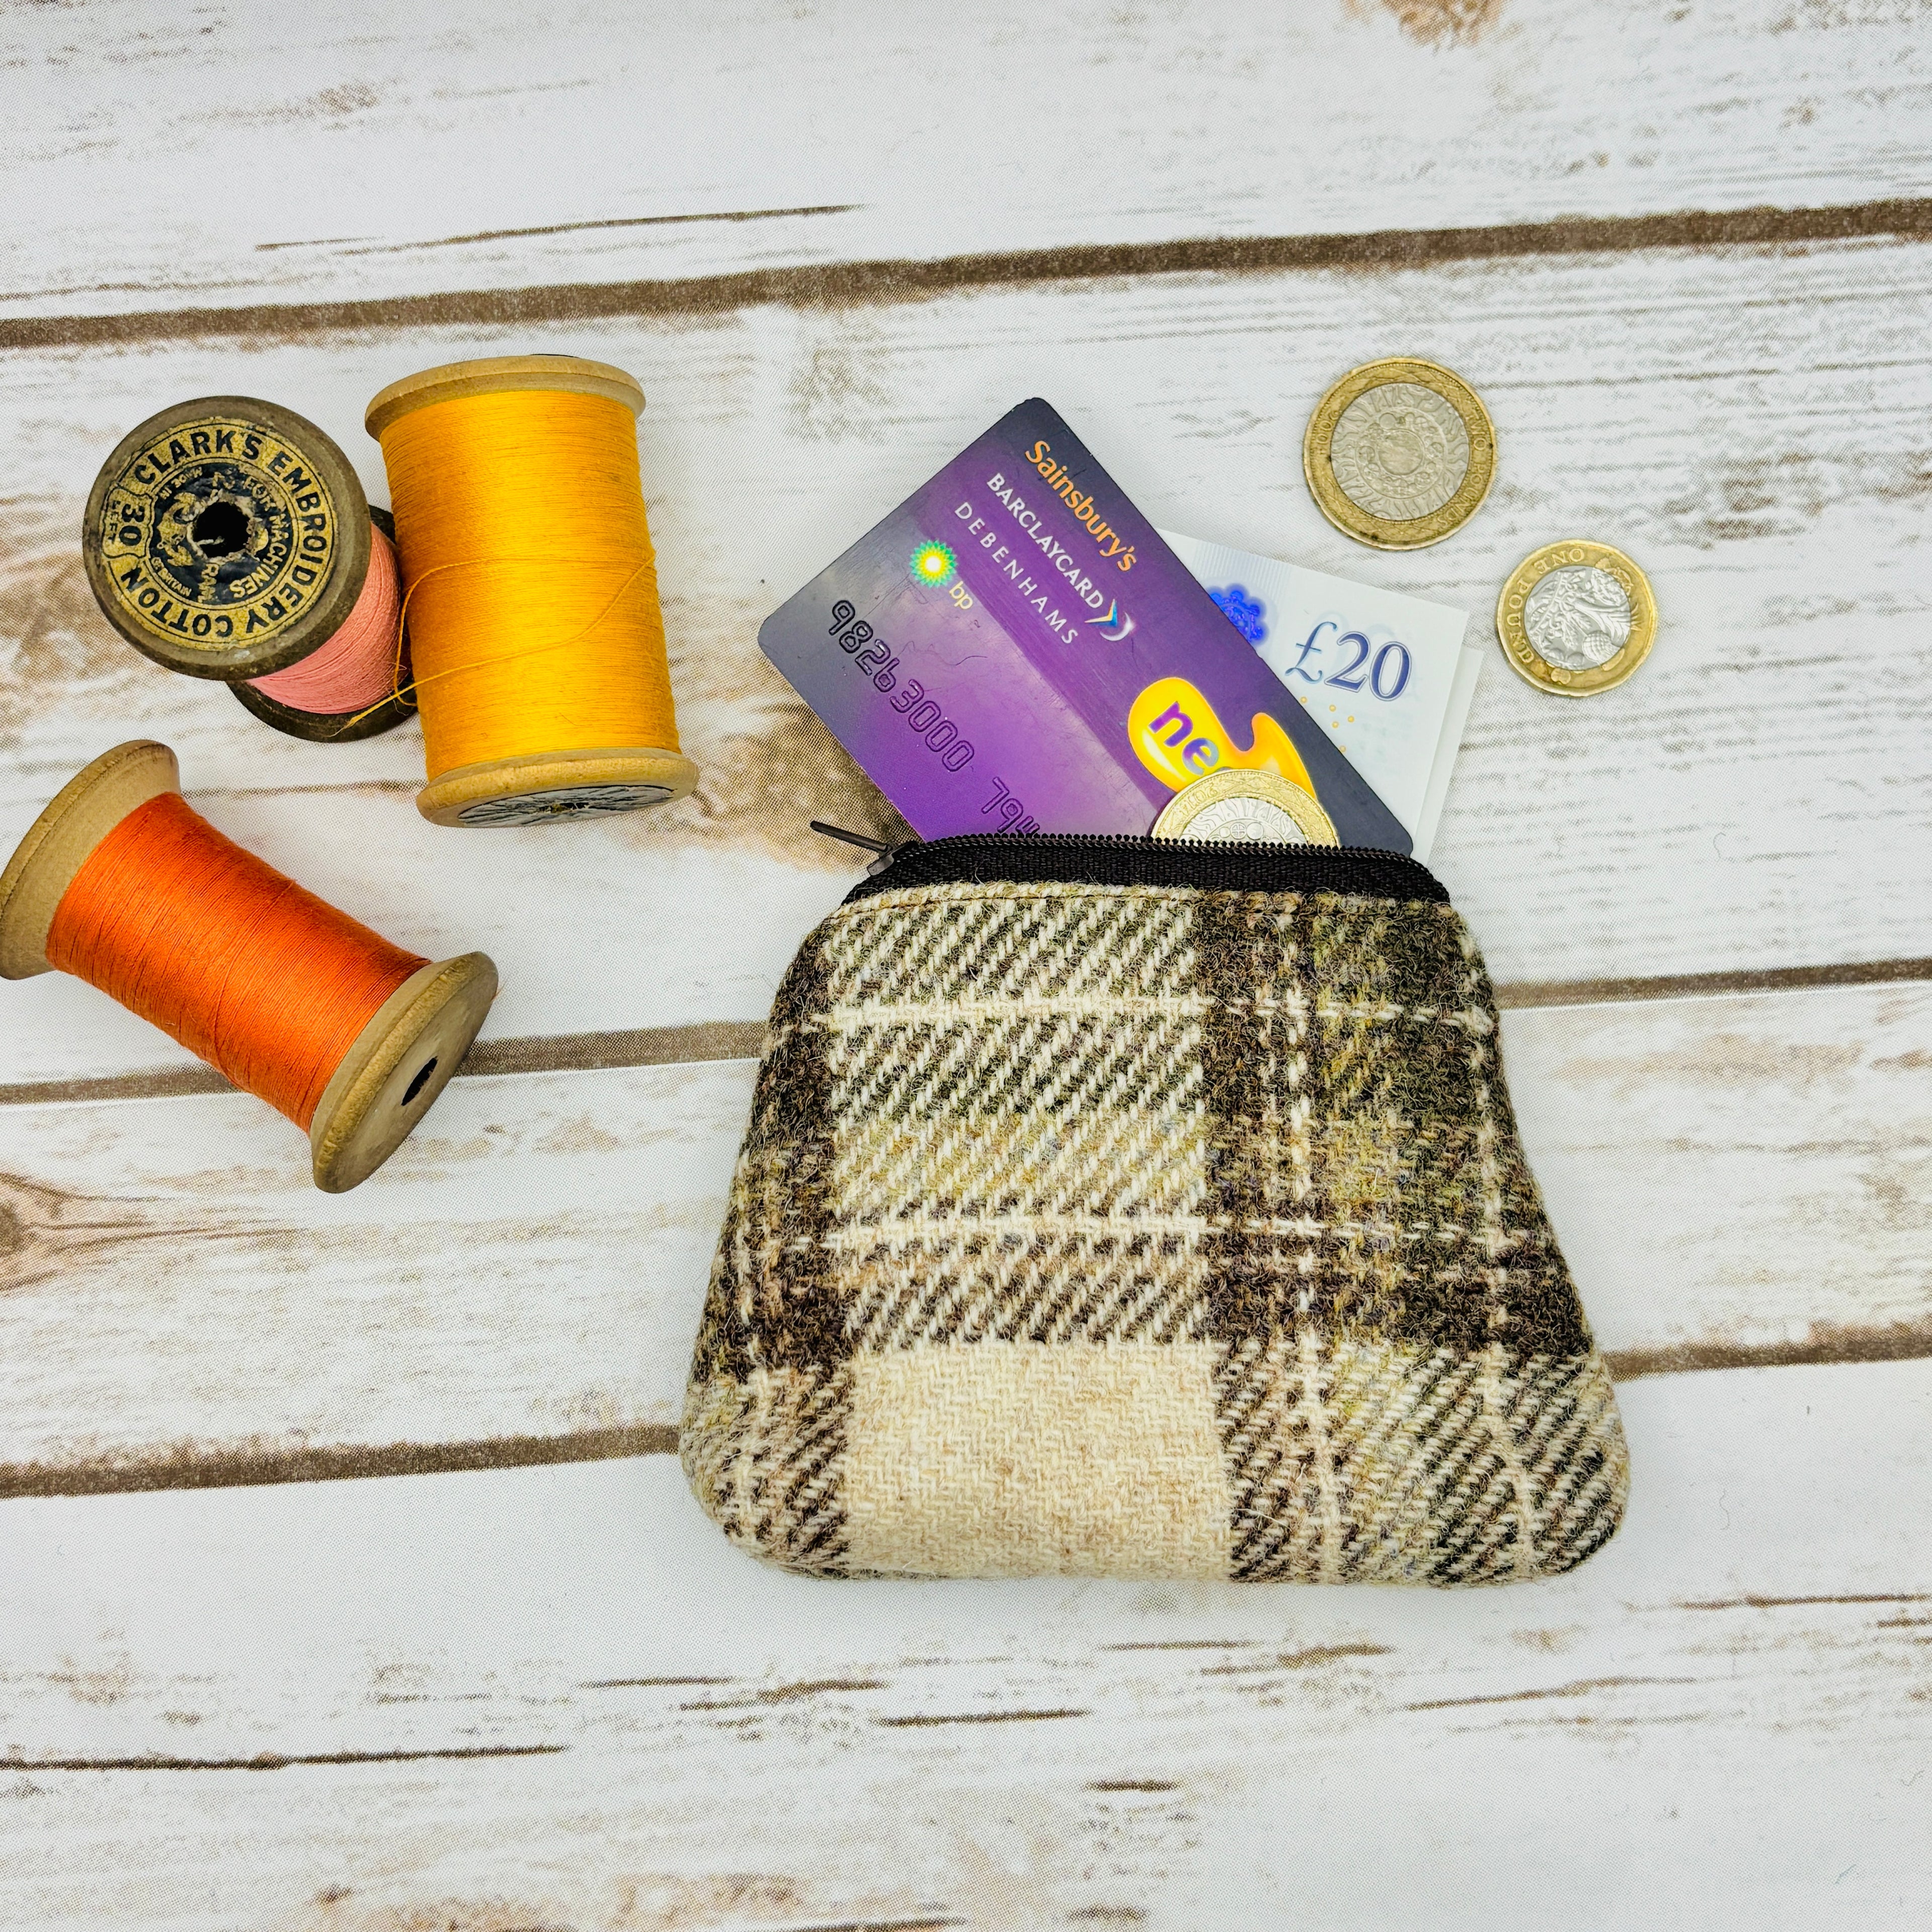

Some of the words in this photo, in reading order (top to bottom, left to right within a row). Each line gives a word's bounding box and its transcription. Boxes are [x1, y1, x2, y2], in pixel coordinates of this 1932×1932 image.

[1465, 412, 1488, 451] TWO
[120, 503, 144, 546] 30
[246, 452, 328, 633] EMBROIDERY
[986, 473, 1103, 611] BARCLAYCARD
[1024, 440, 1139, 573] Sainsbury's
[229, 513, 289, 598] MACHINES
[953, 502, 1079, 645] DEBENHAMS
[1533, 548, 1584, 575] ONE
[121, 567, 233, 636] COTTON
[948, 582, 975, 611] bp
[1507, 581, 1534, 663] POUND
[1284, 621, 1412, 701] £20
